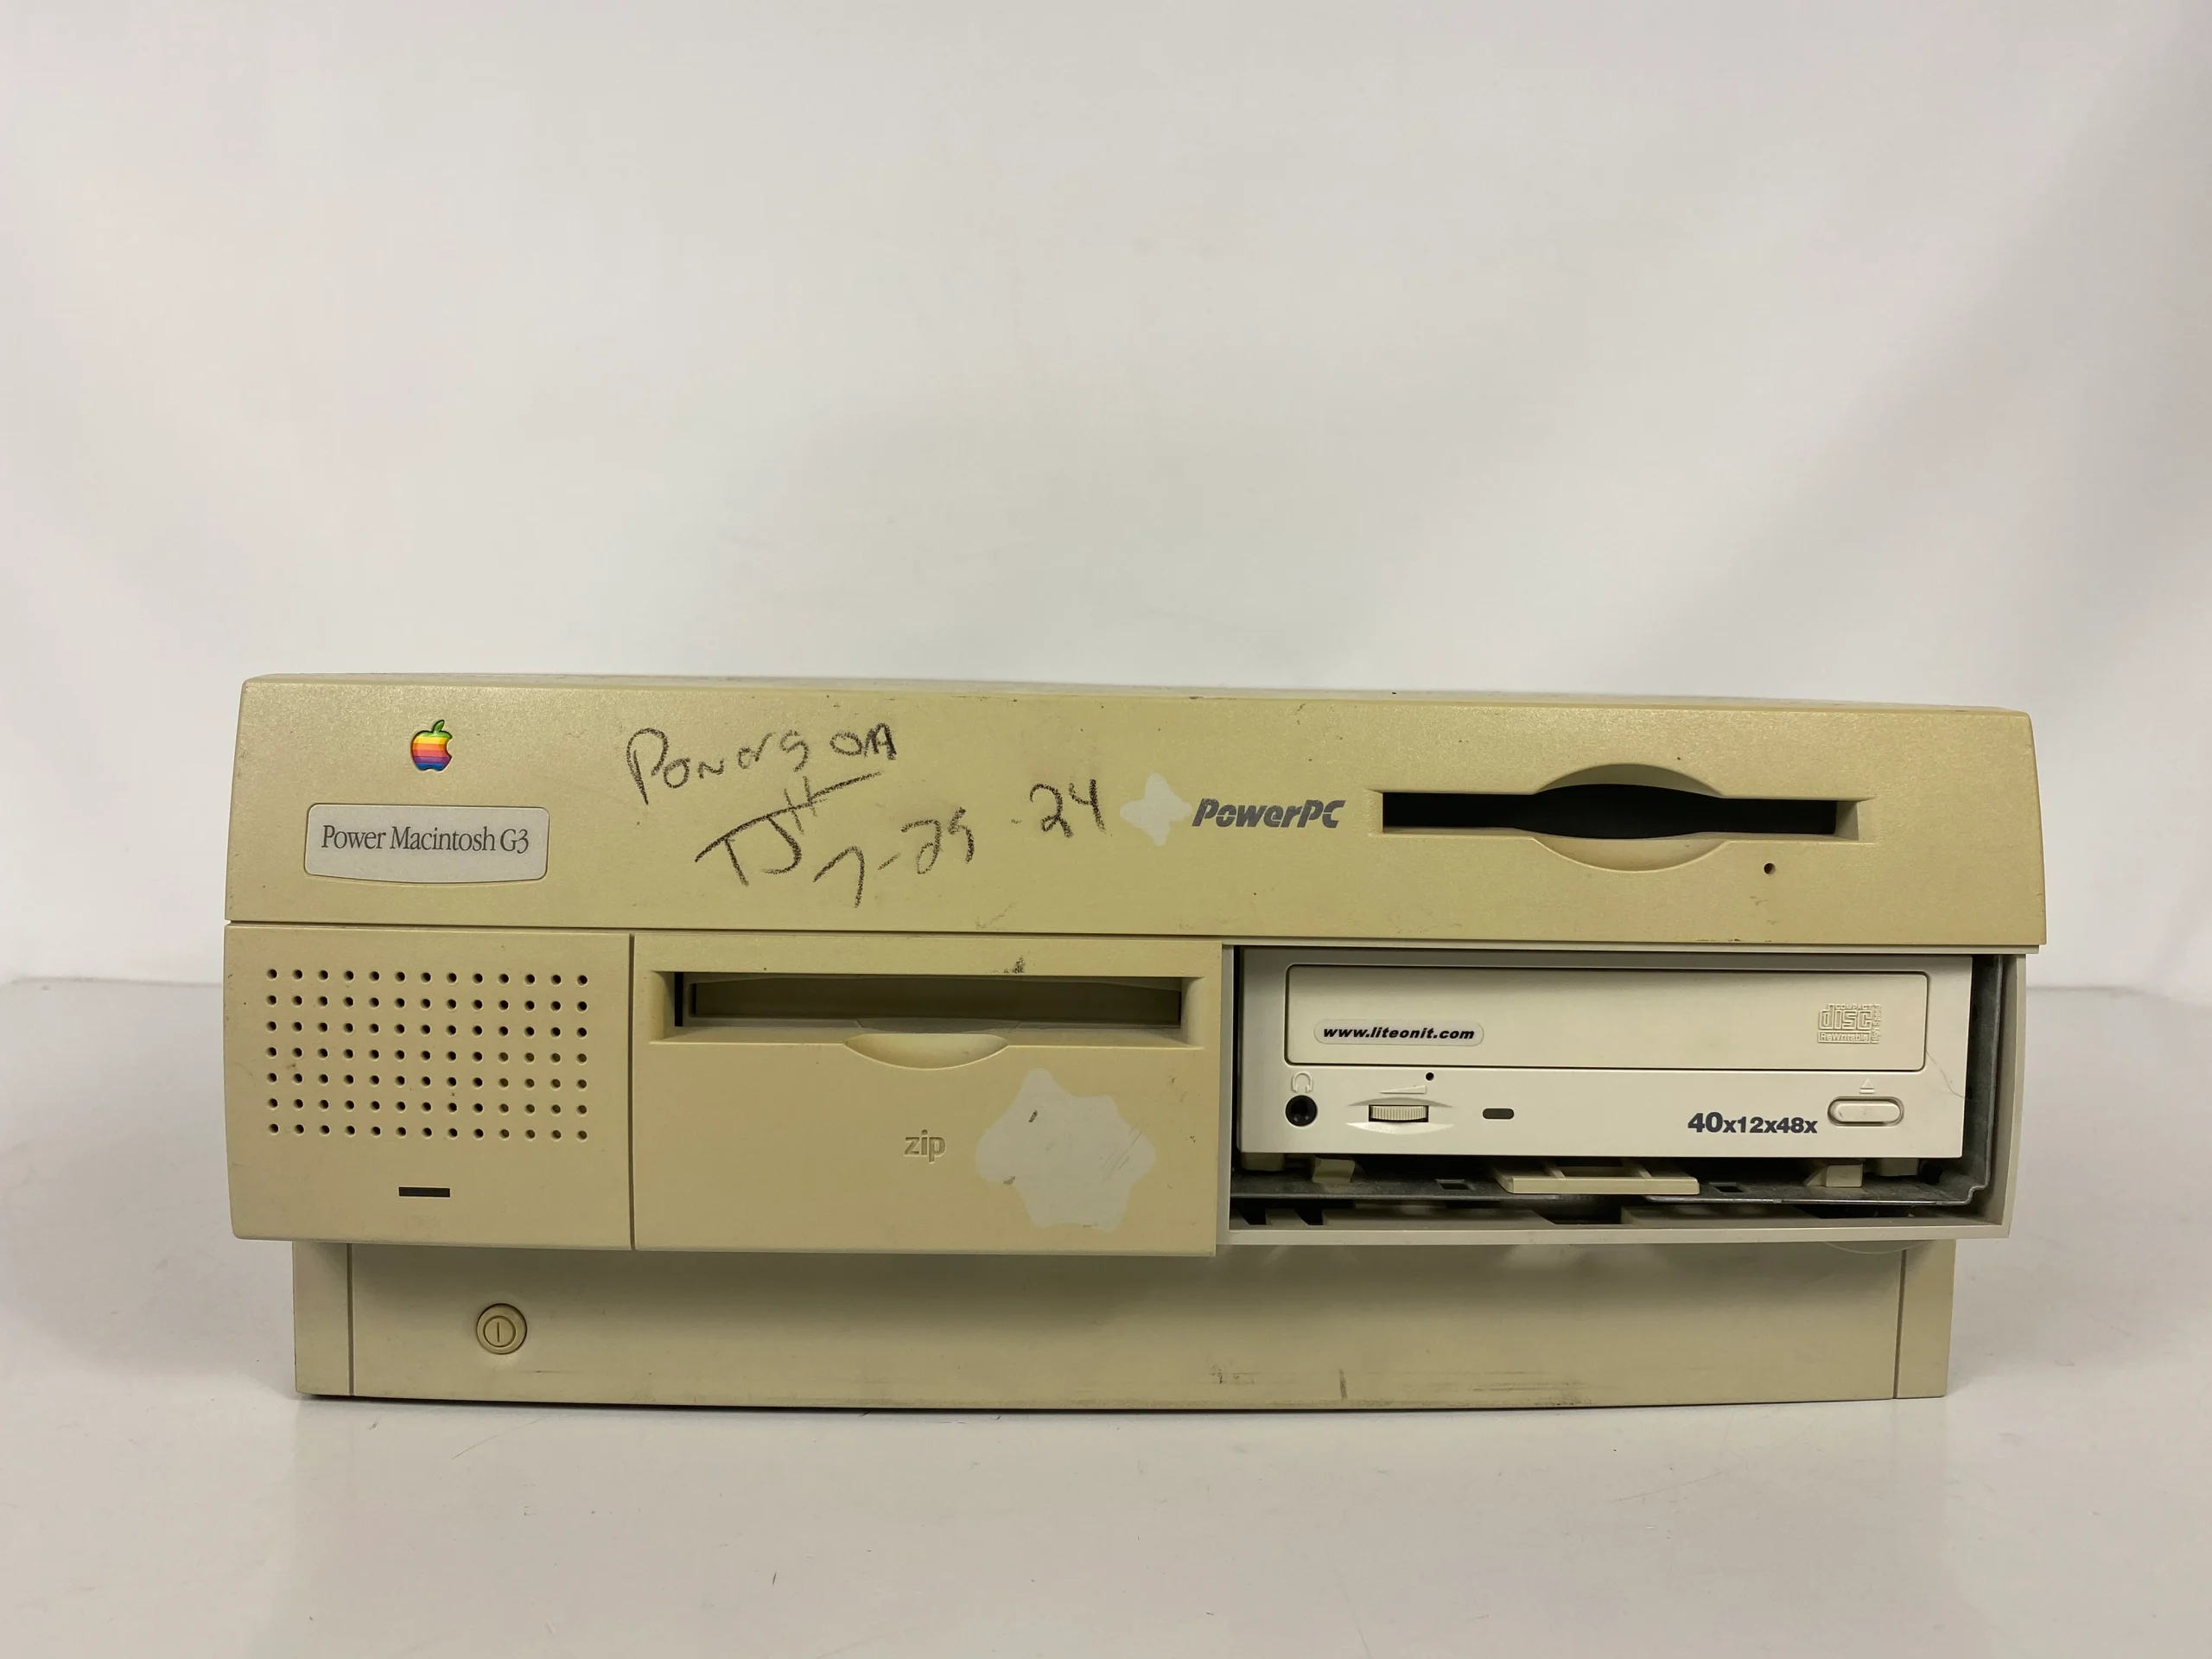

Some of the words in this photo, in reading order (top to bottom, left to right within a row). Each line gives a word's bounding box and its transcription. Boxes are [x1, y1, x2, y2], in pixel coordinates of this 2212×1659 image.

[1192, 798, 1347, 829] PowerPC
[321, 824, 387, 850] Power
[390, 825, 497, 852] Macintosh
[499, 828, 530, 855] G3
[1322, 1026, 1476, 1040] www.liteonit.com
[1687, 1111, 1819, 1134] 40x12x48x
[903, 1128, 948, 1164] zip
